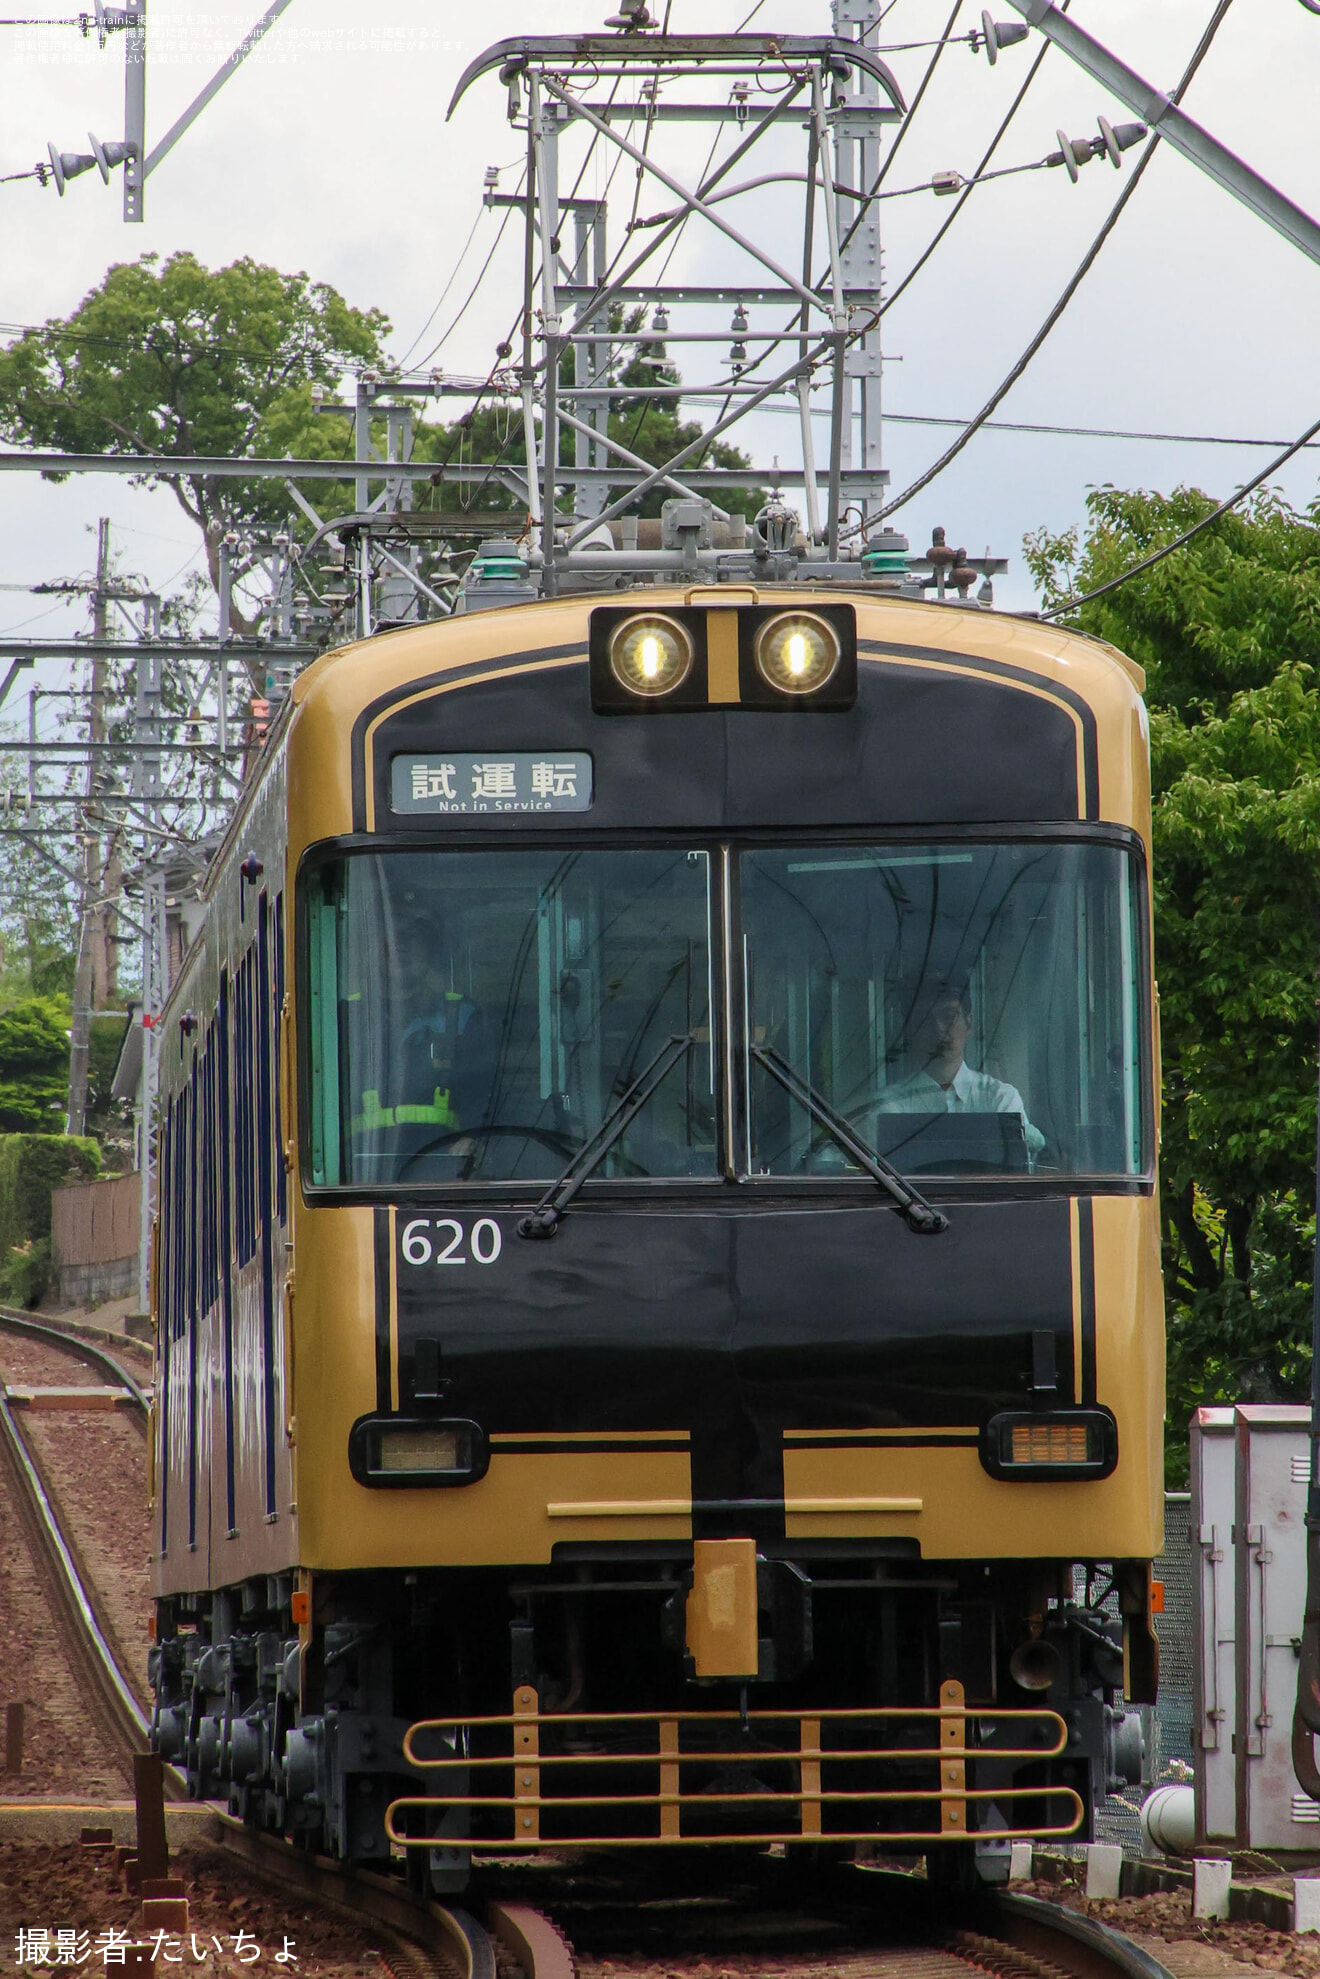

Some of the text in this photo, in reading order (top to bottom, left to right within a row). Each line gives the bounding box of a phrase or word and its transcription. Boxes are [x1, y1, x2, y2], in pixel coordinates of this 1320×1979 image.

[411, 762, 577, 800] 試運転
[439, 800, 552, 812] Not in Service
[402, 1218, 502, 1265] 620
